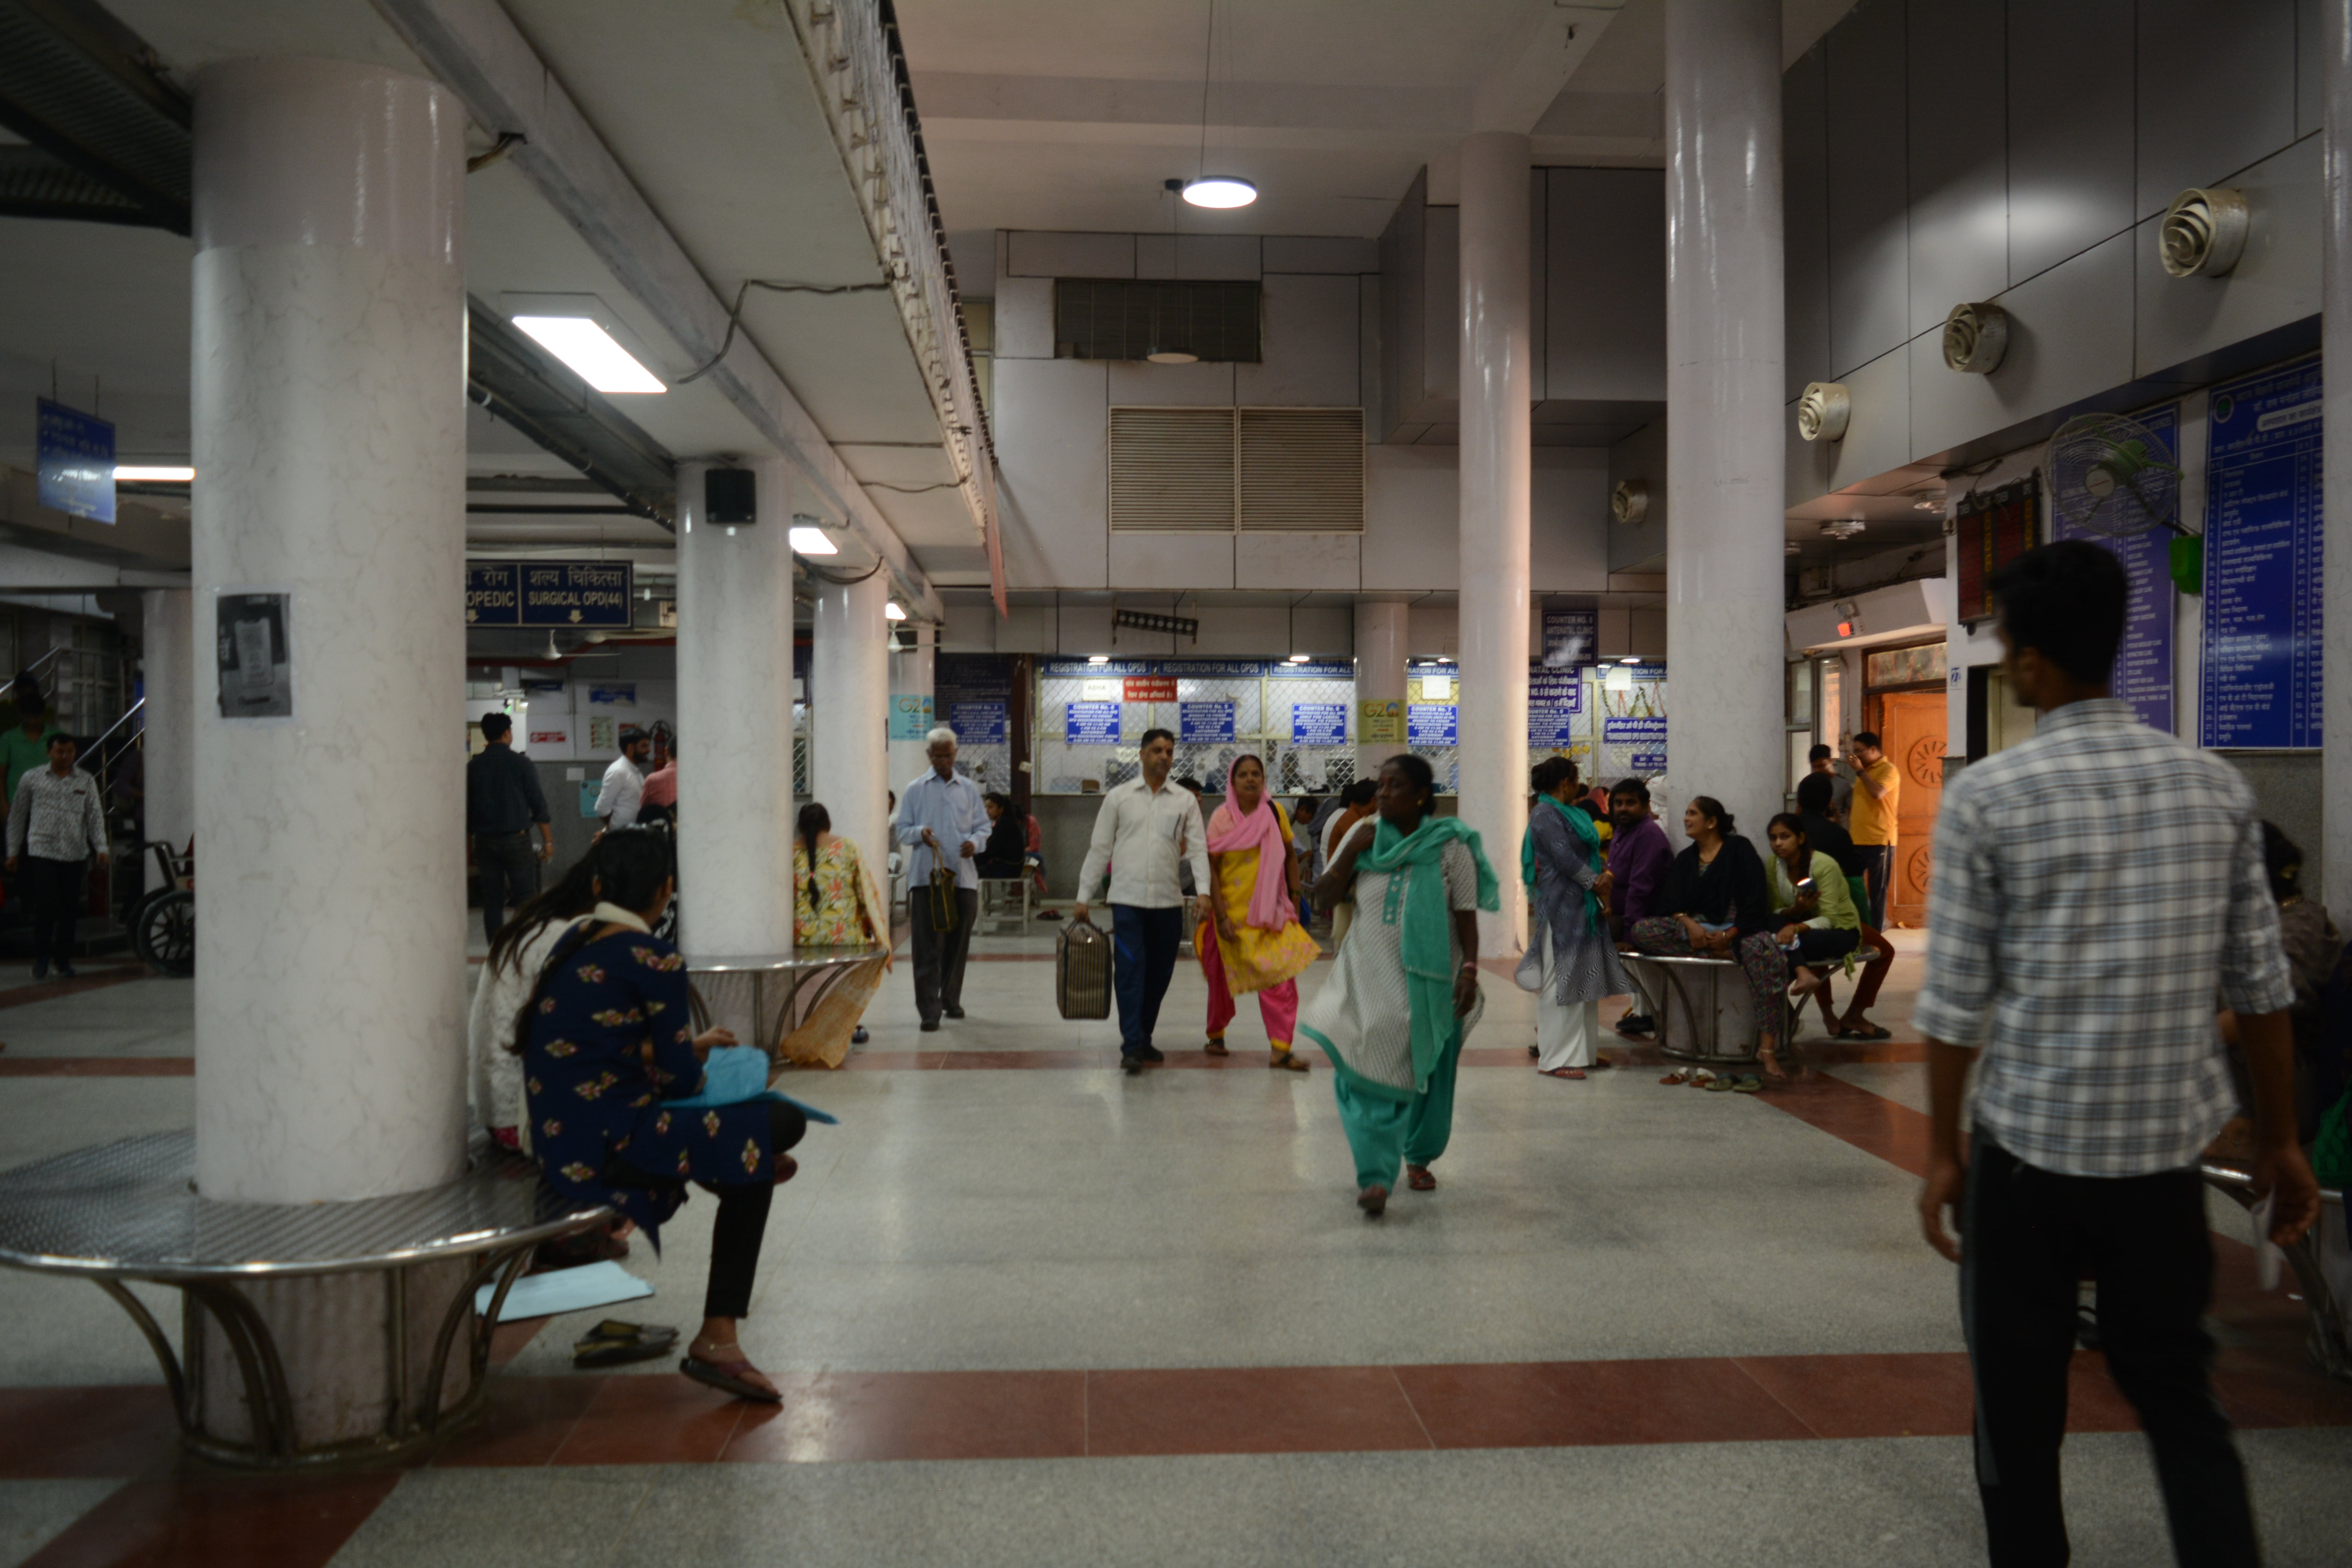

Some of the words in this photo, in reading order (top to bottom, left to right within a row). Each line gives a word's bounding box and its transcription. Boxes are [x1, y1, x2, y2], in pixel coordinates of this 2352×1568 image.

[482, 567, 509, 587] रोग
[530, 570, 559, 586] शल्य
[567, 566, 623, 587] चिकित्सा
[466, 591, 514, 607] OPEDIC
[528, 591, 581, 606] SURGICAL
[583, 591, 622, 609] OPD(44)
[1546, 626, 1575, 634] ANTENATAL
[1577, 626, 1593, 634] CLINIC
[1050, 662, 1097, 673] REGISTRATION
[1099, 662, 1112, 673] FOR
[1114, 663, 1127, 673] ALL
[1128, 662, 1146, 673] OPDS
[1163, 663, 1211, 673] REGISTRATION
[1212, 663, 1226, 673] FOR
[1227, 663, 1239, 673] ALL
[1241, 663, 1259, 673] OPDS
